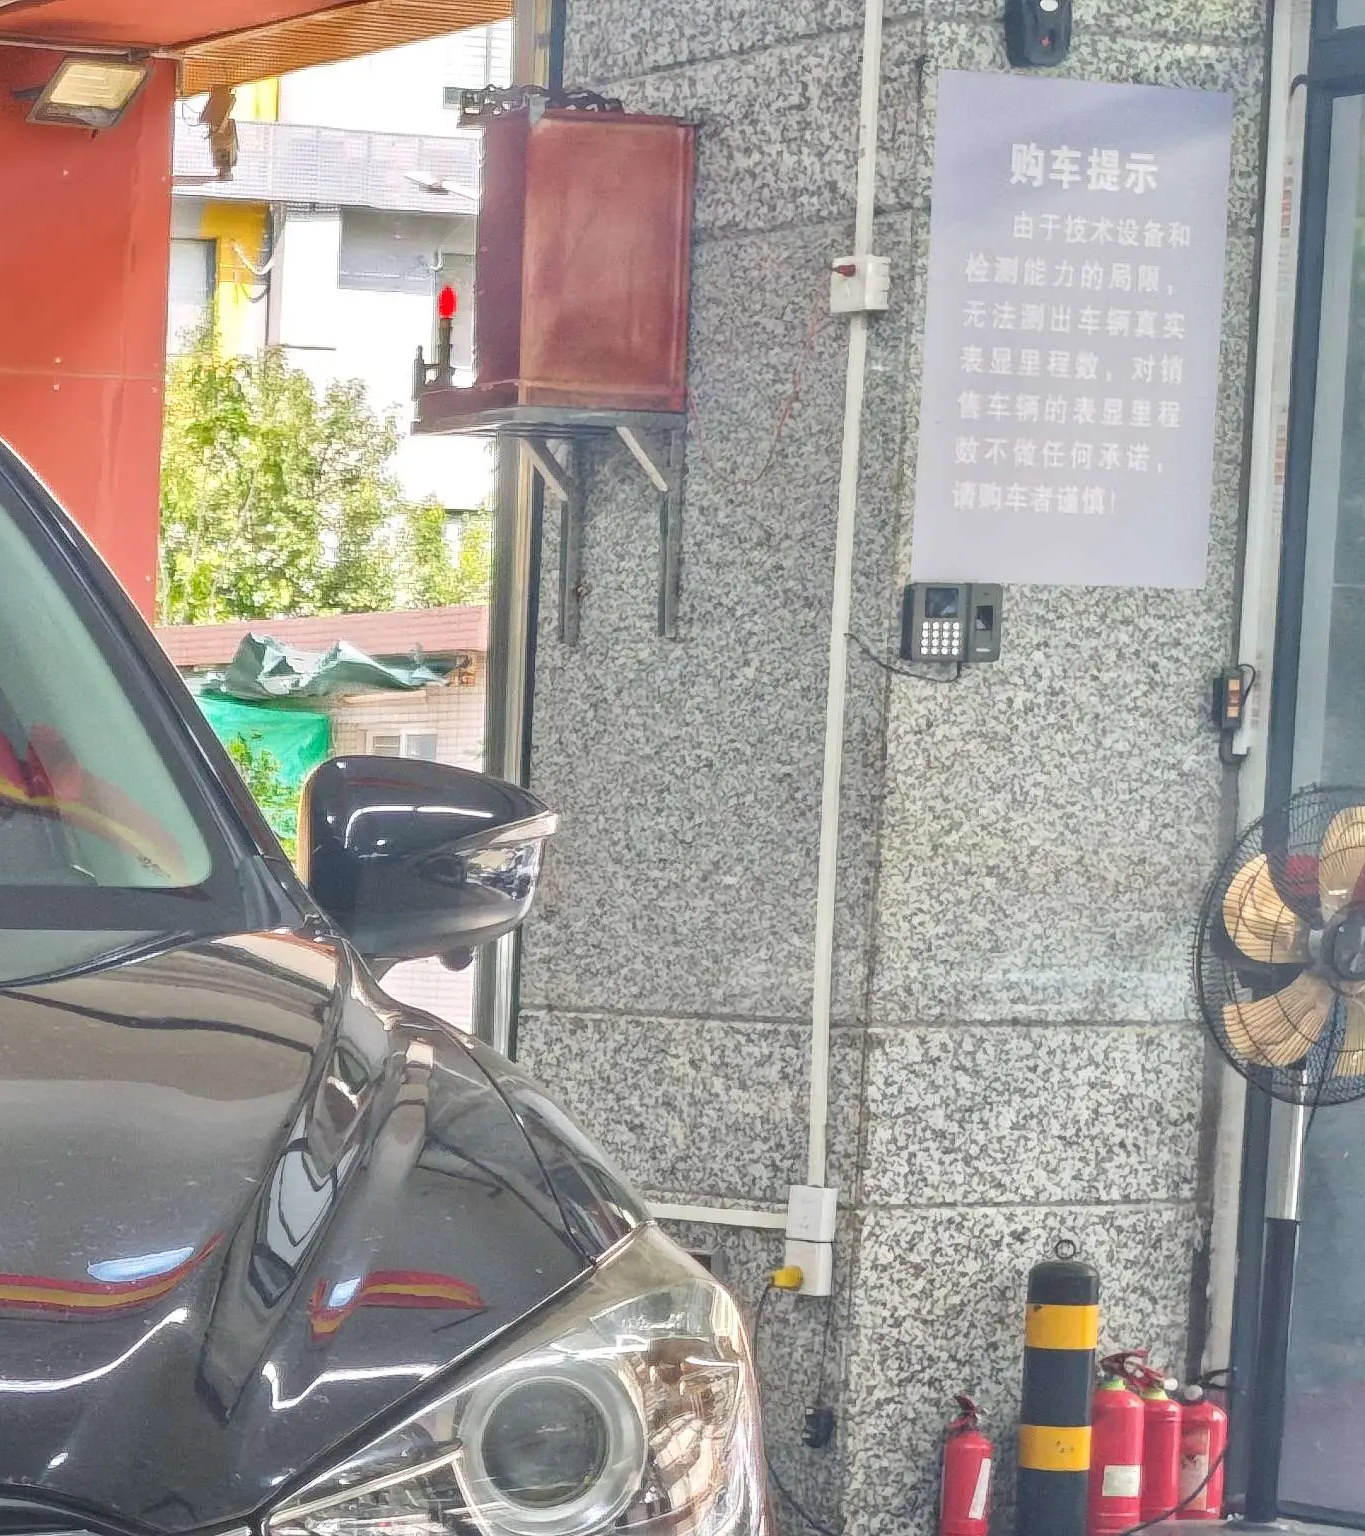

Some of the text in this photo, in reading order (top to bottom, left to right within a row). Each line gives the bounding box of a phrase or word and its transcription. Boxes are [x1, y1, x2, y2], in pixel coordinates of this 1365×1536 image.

[1010, 142, 1159, 194] 购车提示
[1013, 211, 1192, 249] 由于技术设备和
[965, 252, 1174, 295] 检测能力的局限，
[963, 300, 1186, 339] 无法测出车辆真实
[960, 344, 1184, 385] 表显里程数，对销
[957, 390, 1182, 428] 售车辆的表显里程
[955, 436, 1164, 474] 数不做任何承诺，
[952, 480, 1117, 514] 请购车者谨慎！
